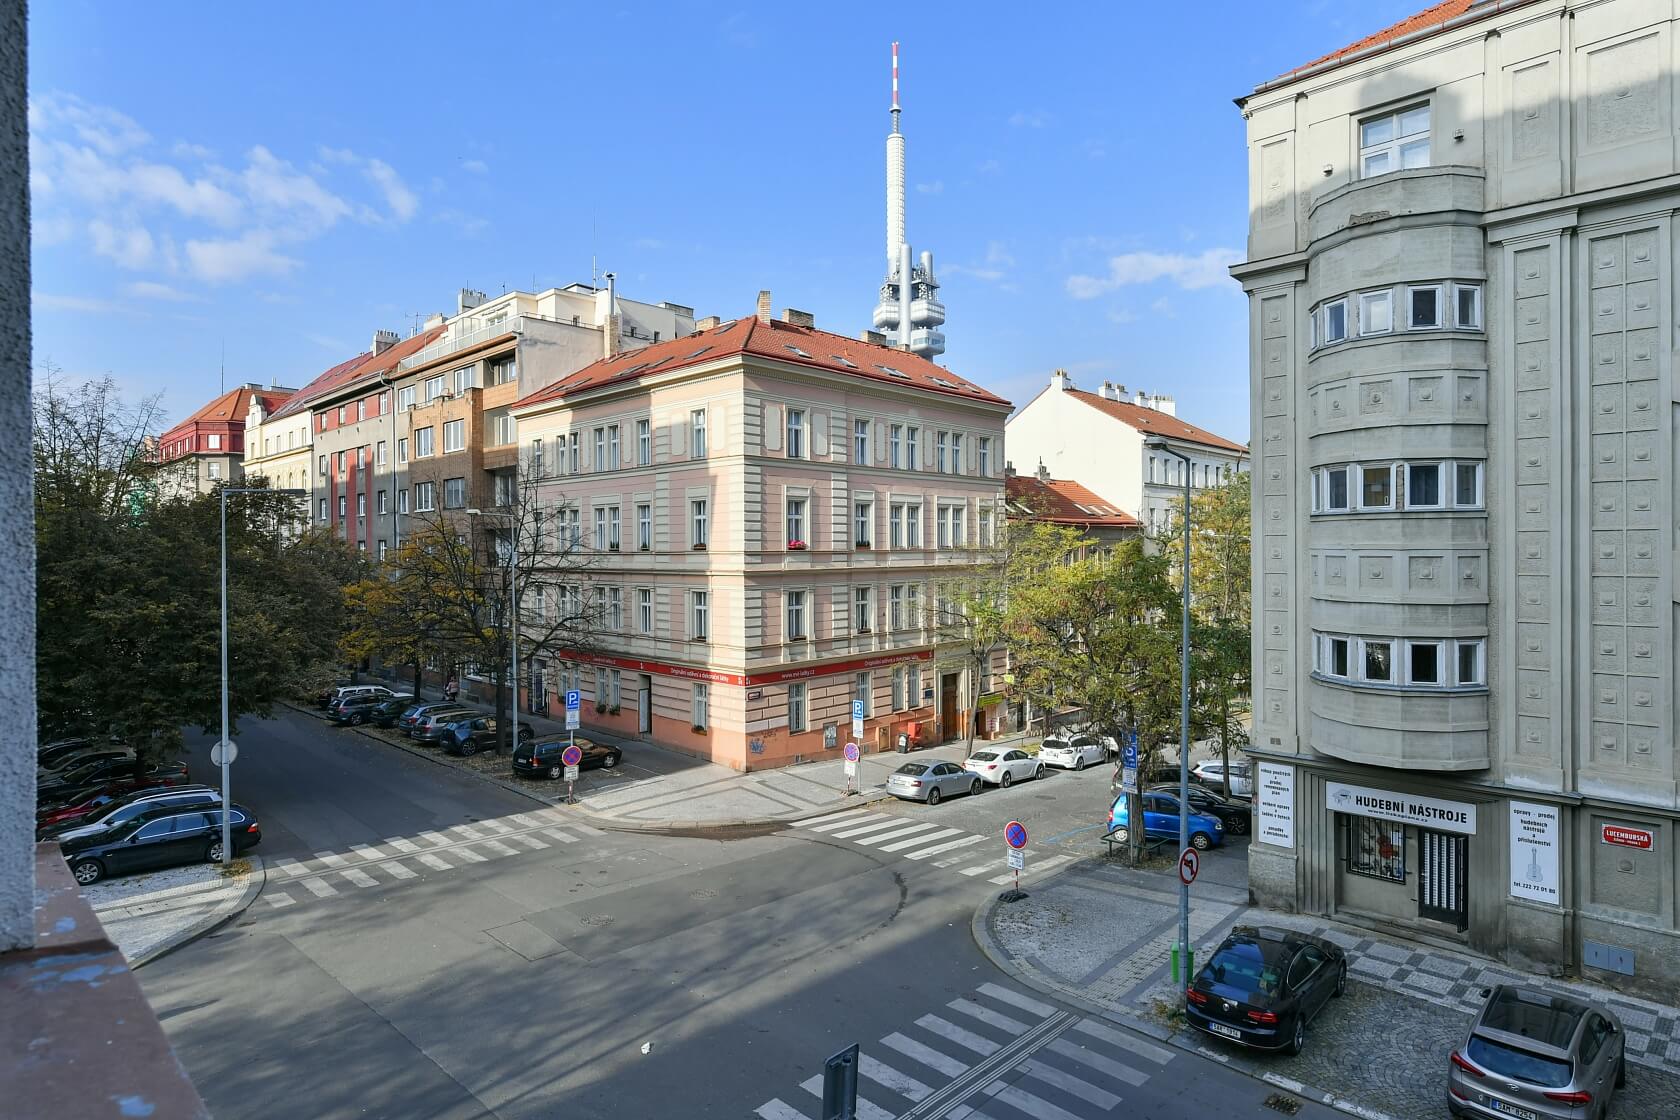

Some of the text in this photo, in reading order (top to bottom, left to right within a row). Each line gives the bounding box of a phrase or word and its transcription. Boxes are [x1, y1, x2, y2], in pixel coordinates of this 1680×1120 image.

[569, 692, 577, 704] P
[854, 702, 861, 711] P
[1355, 795, 1467, 823] HUDEBNÍ NÁSTROJE
[1513, 808, 1531, 817] opravy
[1606, 829, 1649, 842] LUCEMBURSKÁ
